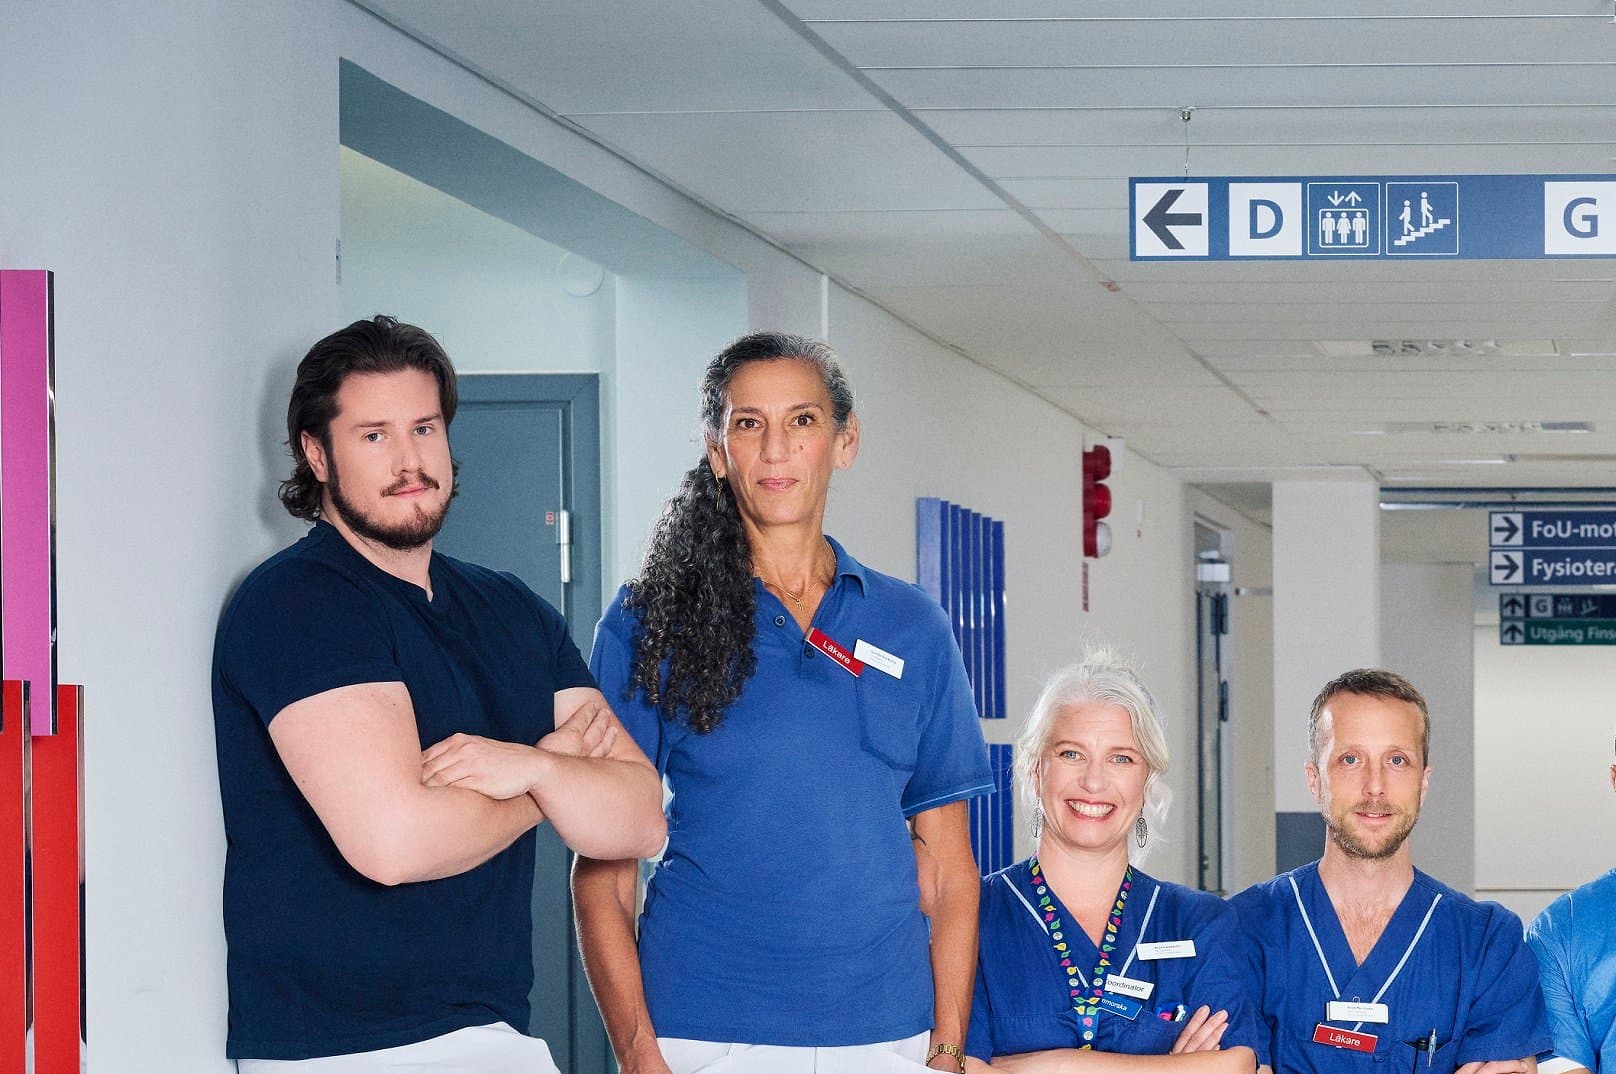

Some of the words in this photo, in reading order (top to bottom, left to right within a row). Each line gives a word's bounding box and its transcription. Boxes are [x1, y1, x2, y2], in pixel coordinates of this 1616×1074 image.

[1248, 198, 1284, 240] D
[1562, 196, 1599, 239] G
[1535, 599, 1548, 613] G
[1531, 626, 1583, 642] Utgång
[822, 640, 851, 665] Läkare
[1107, 980, 1145, 992] oordinator
[1329, 1032, 1361, 1047] Läkare
